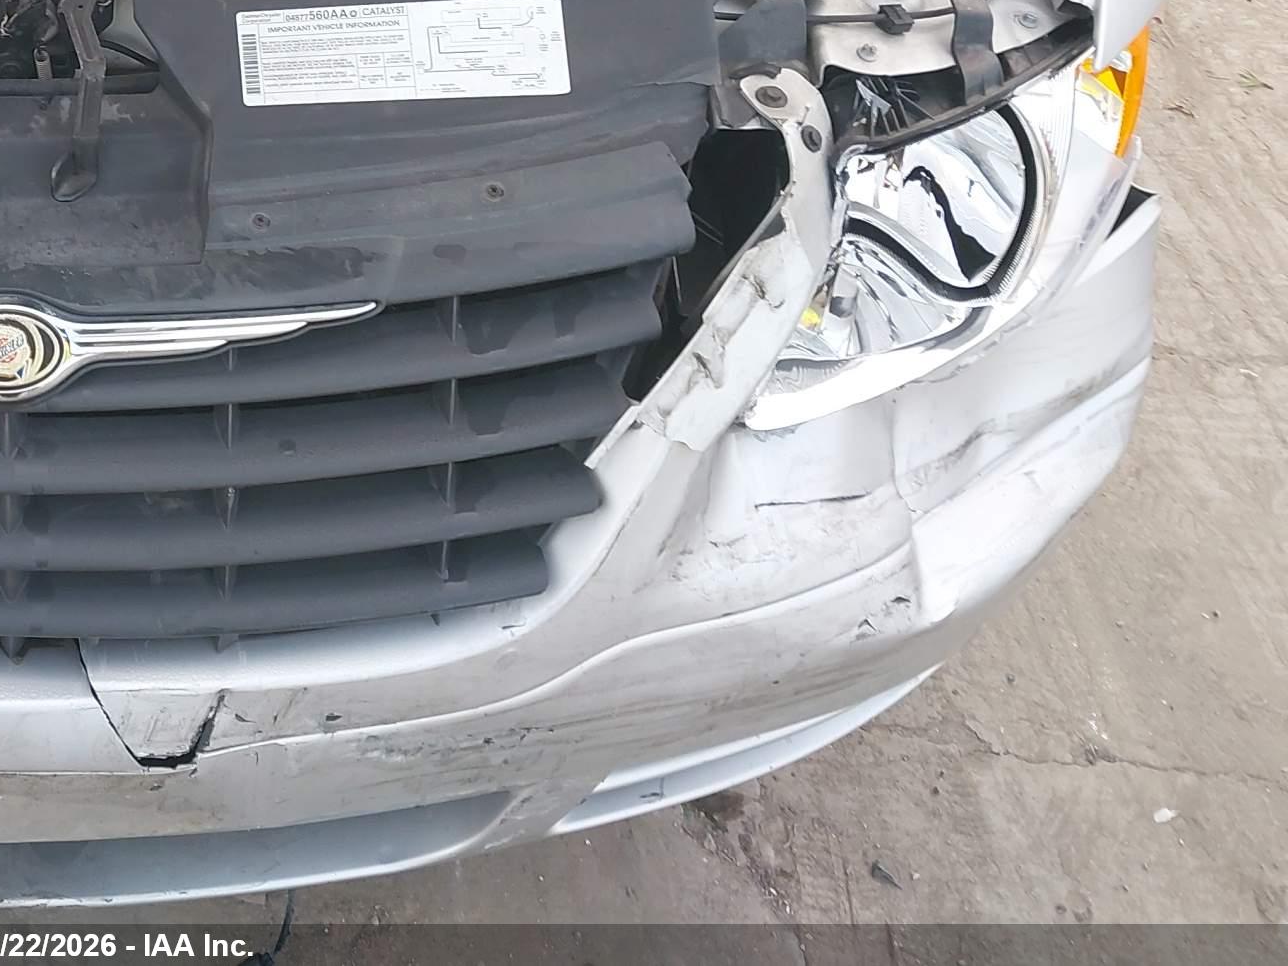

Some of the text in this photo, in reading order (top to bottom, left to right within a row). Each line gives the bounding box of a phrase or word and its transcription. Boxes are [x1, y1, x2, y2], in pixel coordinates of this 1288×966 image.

[362, 6, 405, 16] CATALYST
[267, 19, 400, 33] IMPORTANT VEHICLE INFORMATION
